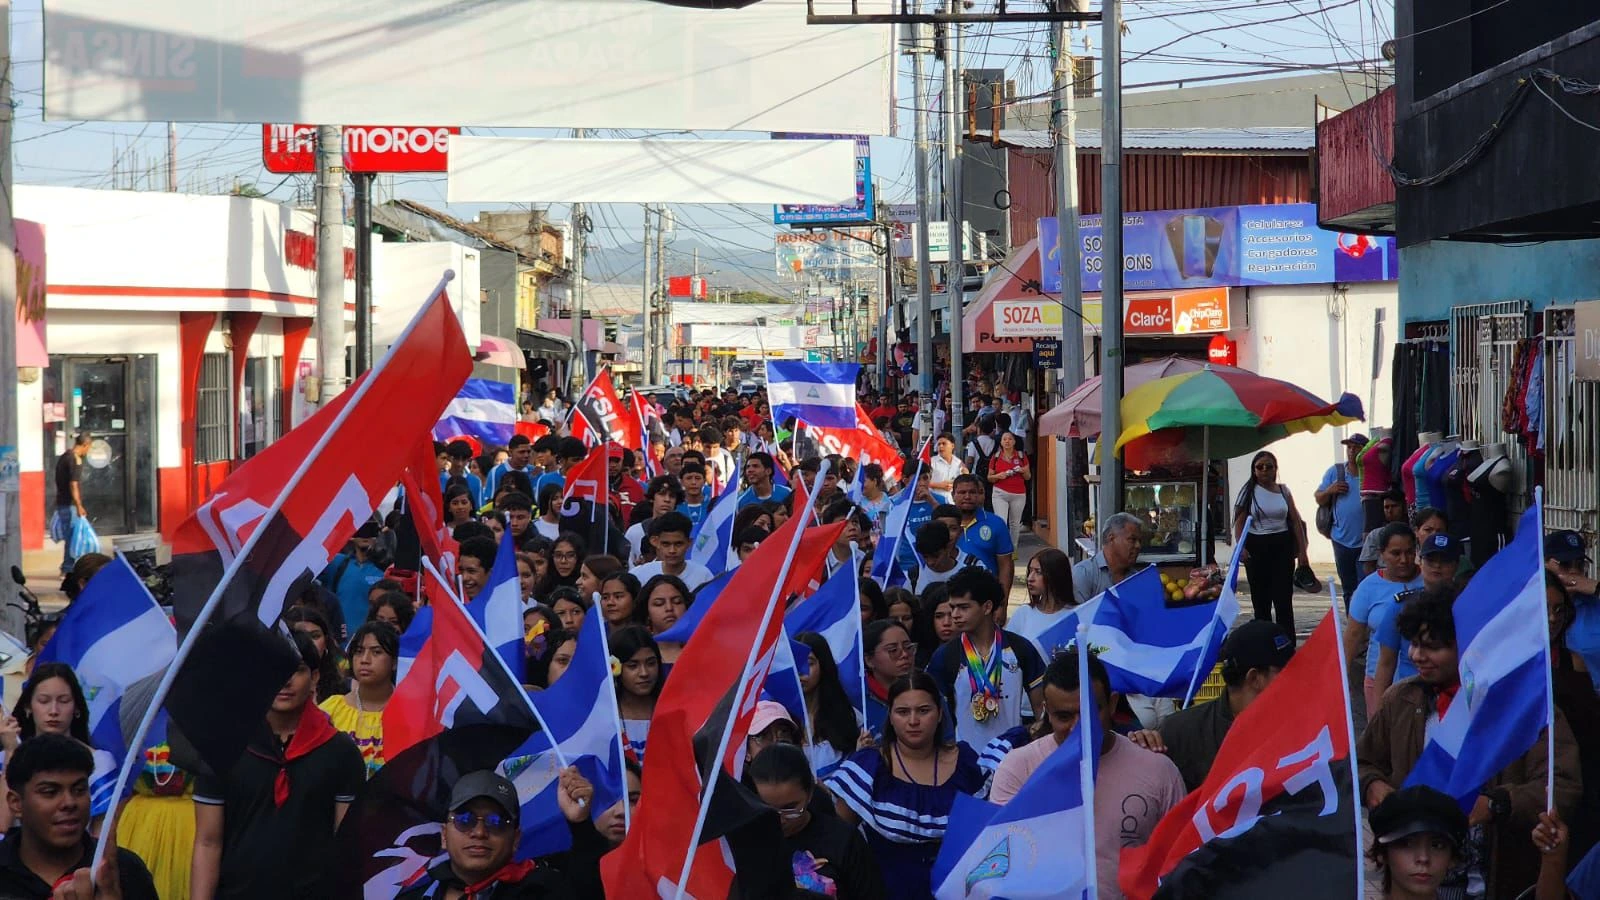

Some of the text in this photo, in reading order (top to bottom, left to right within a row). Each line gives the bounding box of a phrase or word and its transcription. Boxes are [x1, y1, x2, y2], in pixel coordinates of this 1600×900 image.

[271, 124, 448, 153] MAMOROS
[1003, 307, 1041, 324] SOZA
[1130, 311, 1164, 327] Claro
[1209, 347, 1227, 357] Claro
